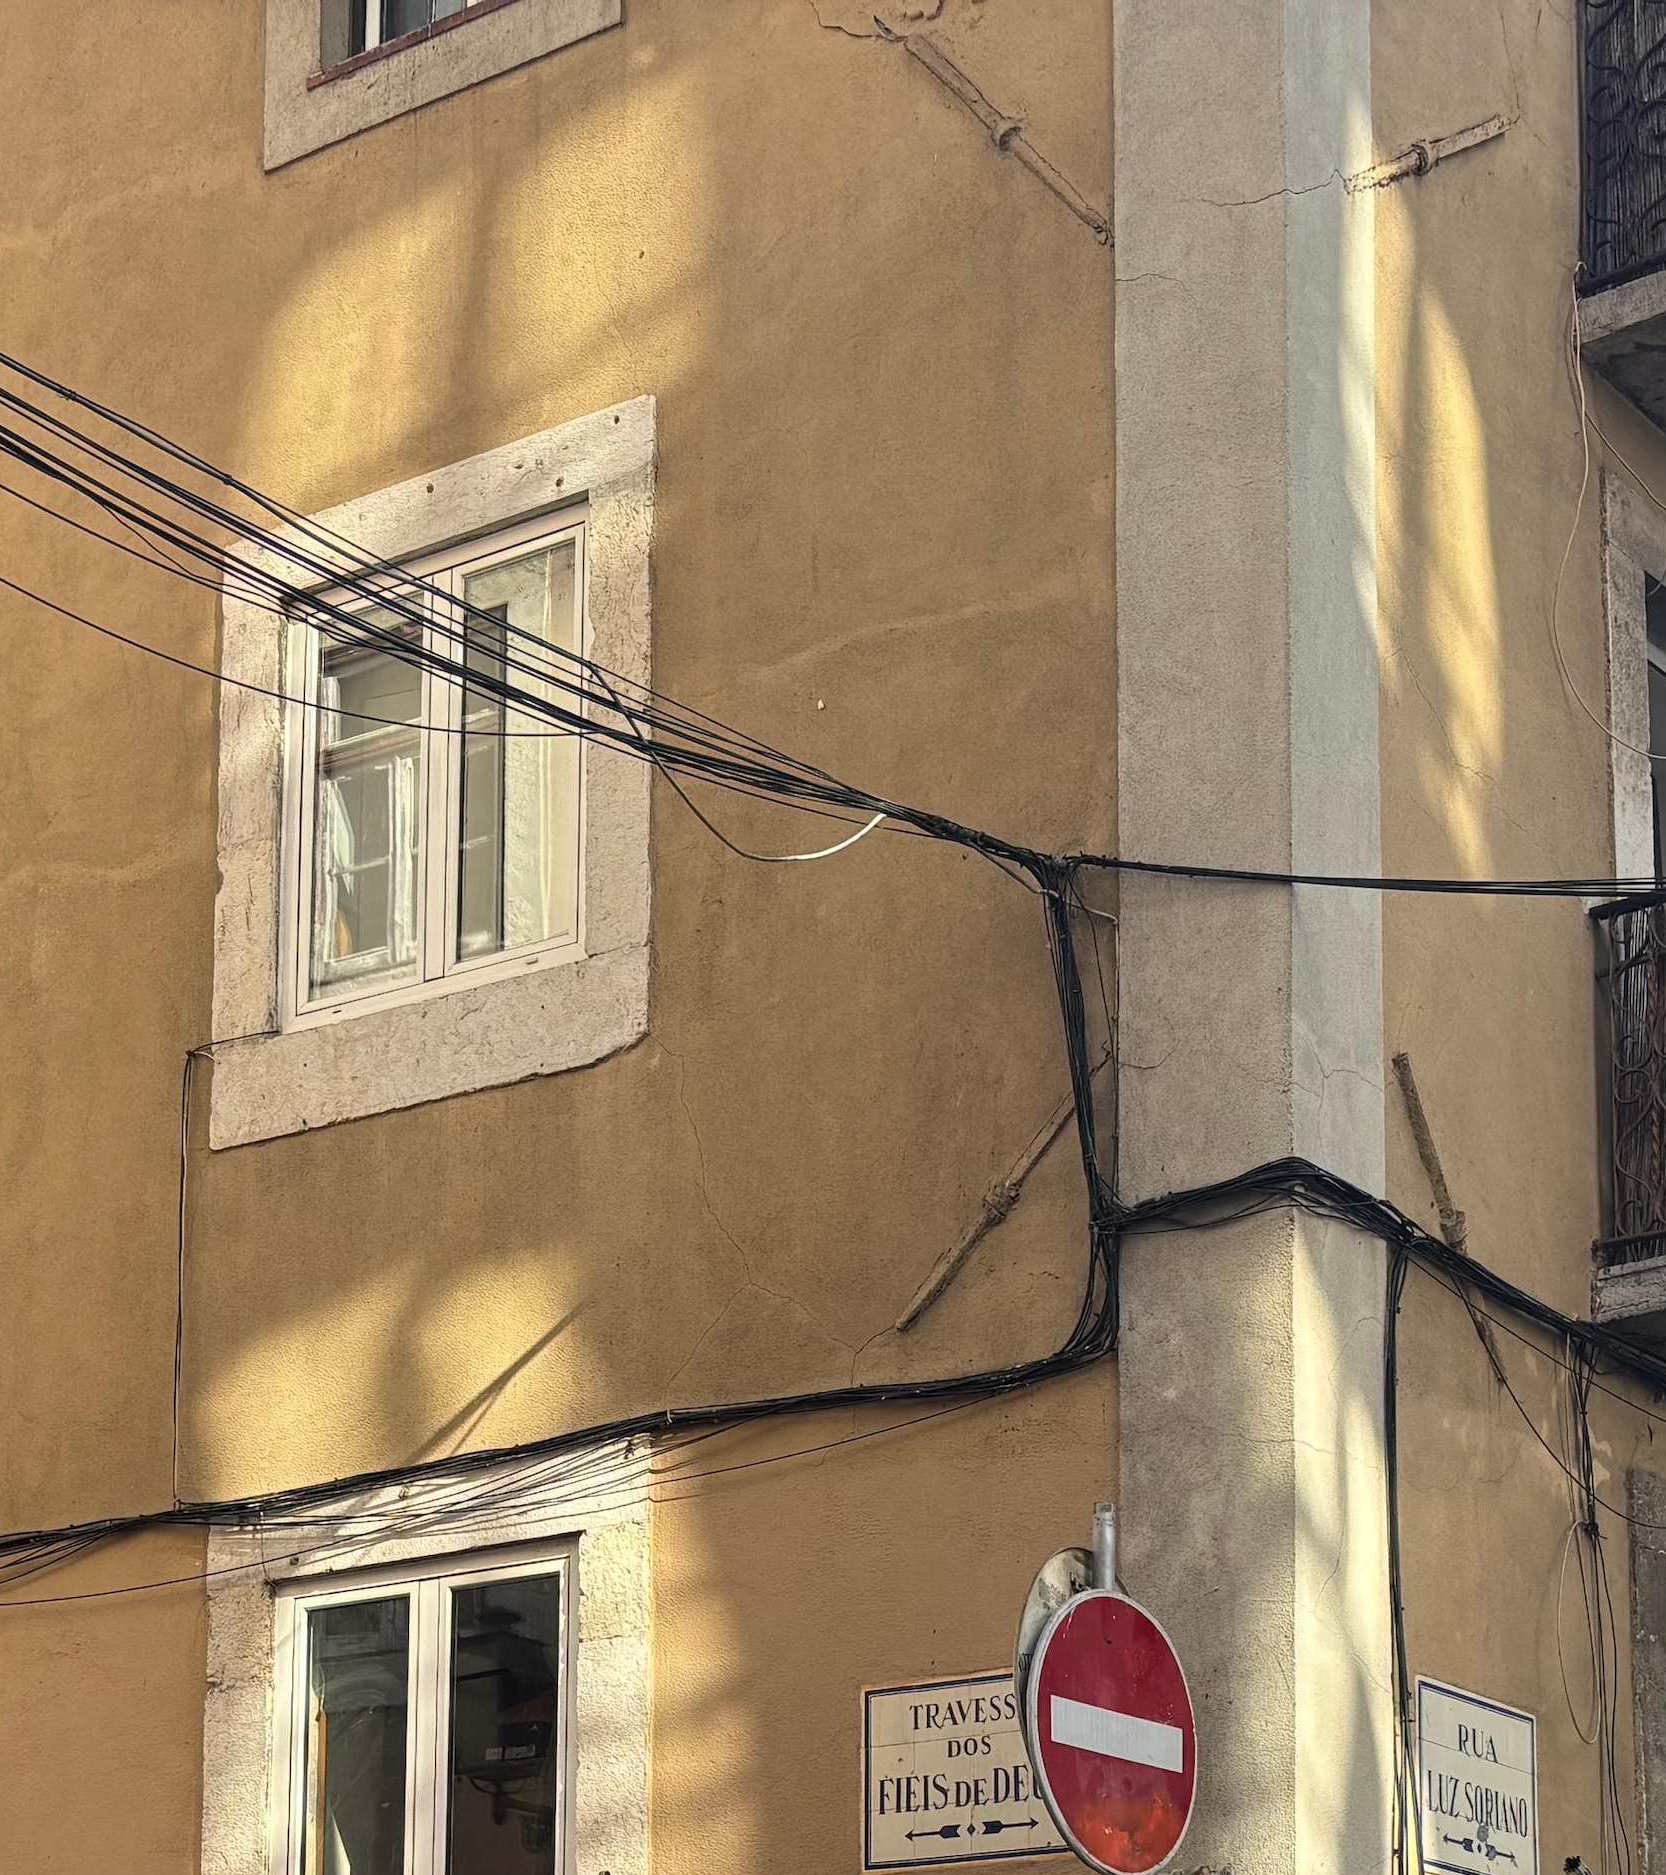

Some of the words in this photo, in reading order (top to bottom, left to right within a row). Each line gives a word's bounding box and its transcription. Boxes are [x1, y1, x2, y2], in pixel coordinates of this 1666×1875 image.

[909, 1693, 1017, 1731] TRAVESS
[947, 1734, 992, 1758] DOS
[1458, 1723, 1499, 1764] RUA
[954, 1778, 988, 1808] DE
[1426, 1770, 1460, 1818] LUZ
[1464, 1781, 1528, 1838] SORIANO
